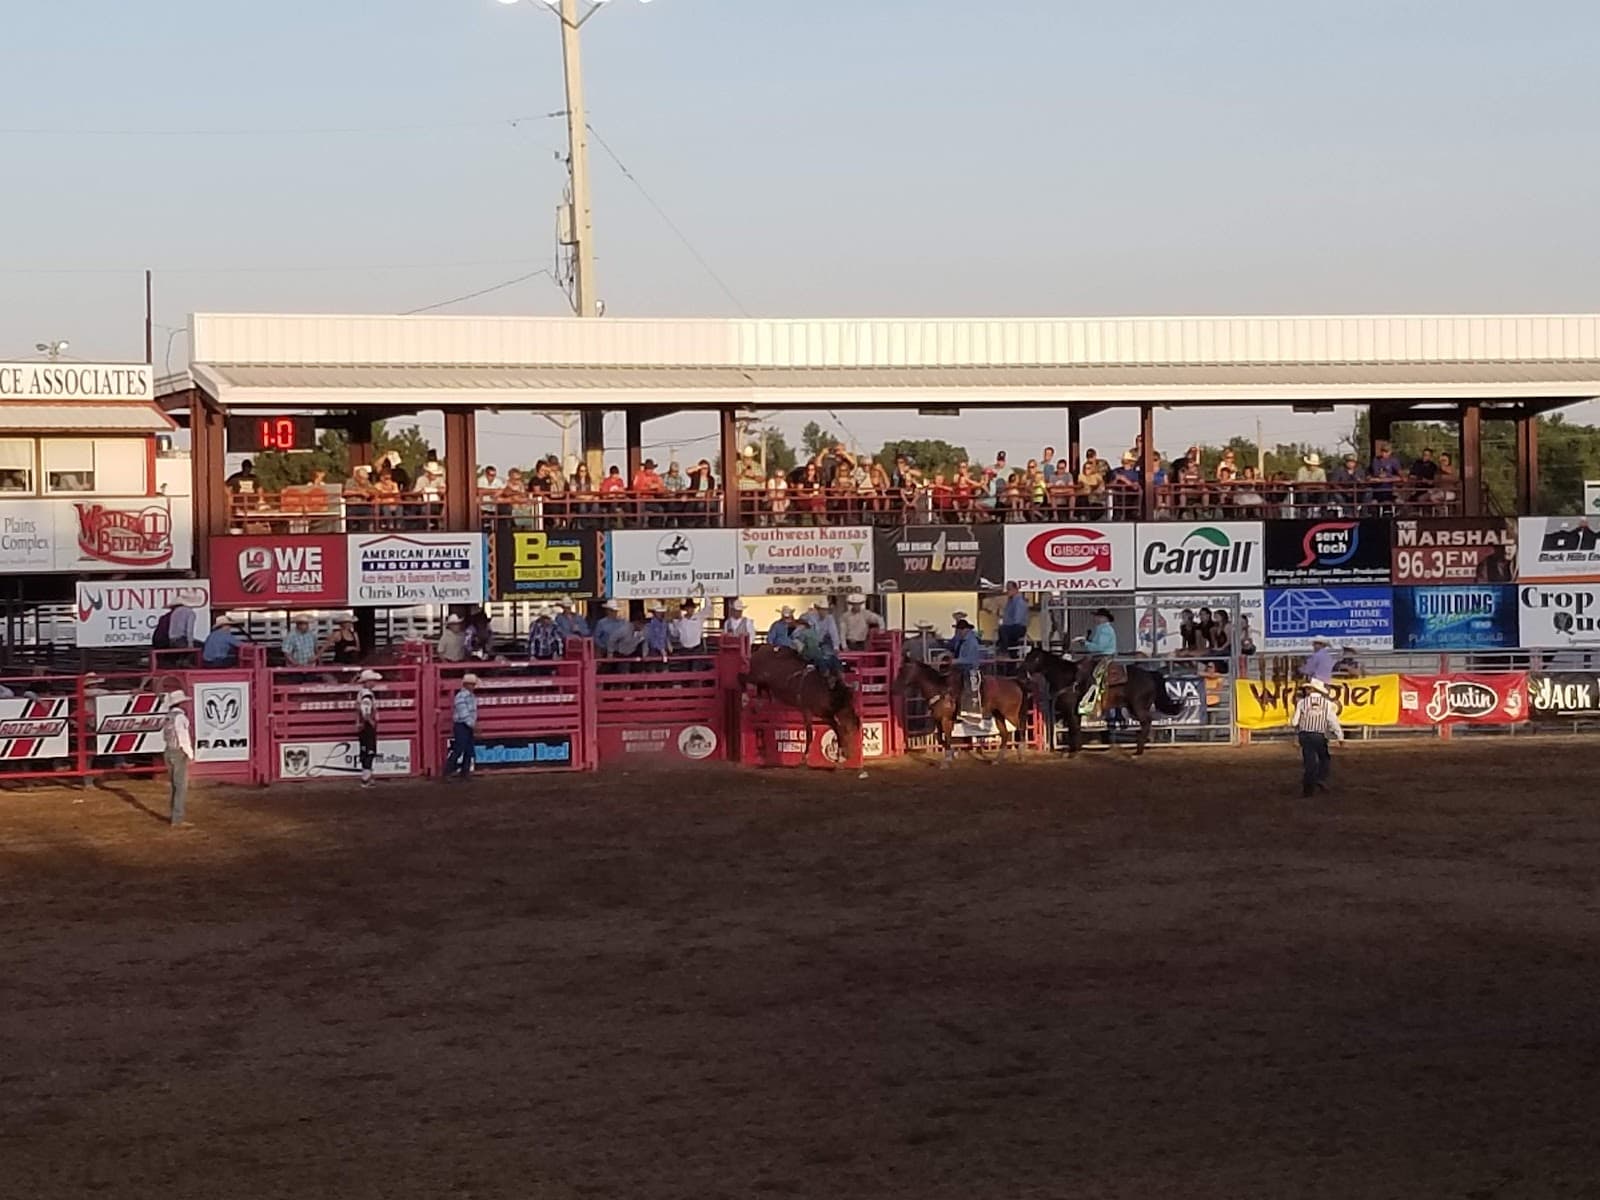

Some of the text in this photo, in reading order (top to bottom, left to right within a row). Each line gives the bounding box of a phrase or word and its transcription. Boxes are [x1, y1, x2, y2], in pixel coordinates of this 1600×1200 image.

[0, 369, 147, 395] CE ASSOCIATES
[4, 517, 36, 533] Plains
[742, 527, 868, 541] Southwest Kansas
[1398, 530, 1515, 546] MARSHAL
[1, 535, 48, 555] Complex
[768, 544, 843, 559] Cardiology
[1053, 544, 1110, 556] GIBSON'S
[1317, 543, 1347, 553] tech
[274, 547, 322, 571] WE
[362, 548, 470, 560] AMERICAN FAMILY
[1143, 541, 1252, 581] Cargill
[1539, 553, 1564, 562] Black
[369, 561, 463, 570] INSURANCE
[904, 556, 977, 571] YOU LOSE
[1398, 551, 1444, 578] 96.3
[1446, 551, 1478, 566] FM
[277, 571, 323, 584] MEAN
[616, 568, 735, 585] High Plains Journal
[773, 576, 808, 585] Dodge
[1018, 578, 1123, 589] PHARMACY
[360, 586, 392, 599] Chris
[430, 585, 471, 601] Agency
[1521, 587, 1593, 614] Crop
[1343, 599, 1391, 608] SUPERIOR
[1419, 593, 1494, 615] BUILDING
[1350, 609, 1381, 618] HOME
[1310, 619, 1389, 629] IMPROVEMENTS
[1250, 682, 1380, 717] Wrgler
[1426, 681, 1493, 721] Justin
[1535, 678, 1591, 709] JACK
[197, 738, 248, 749] RAM
